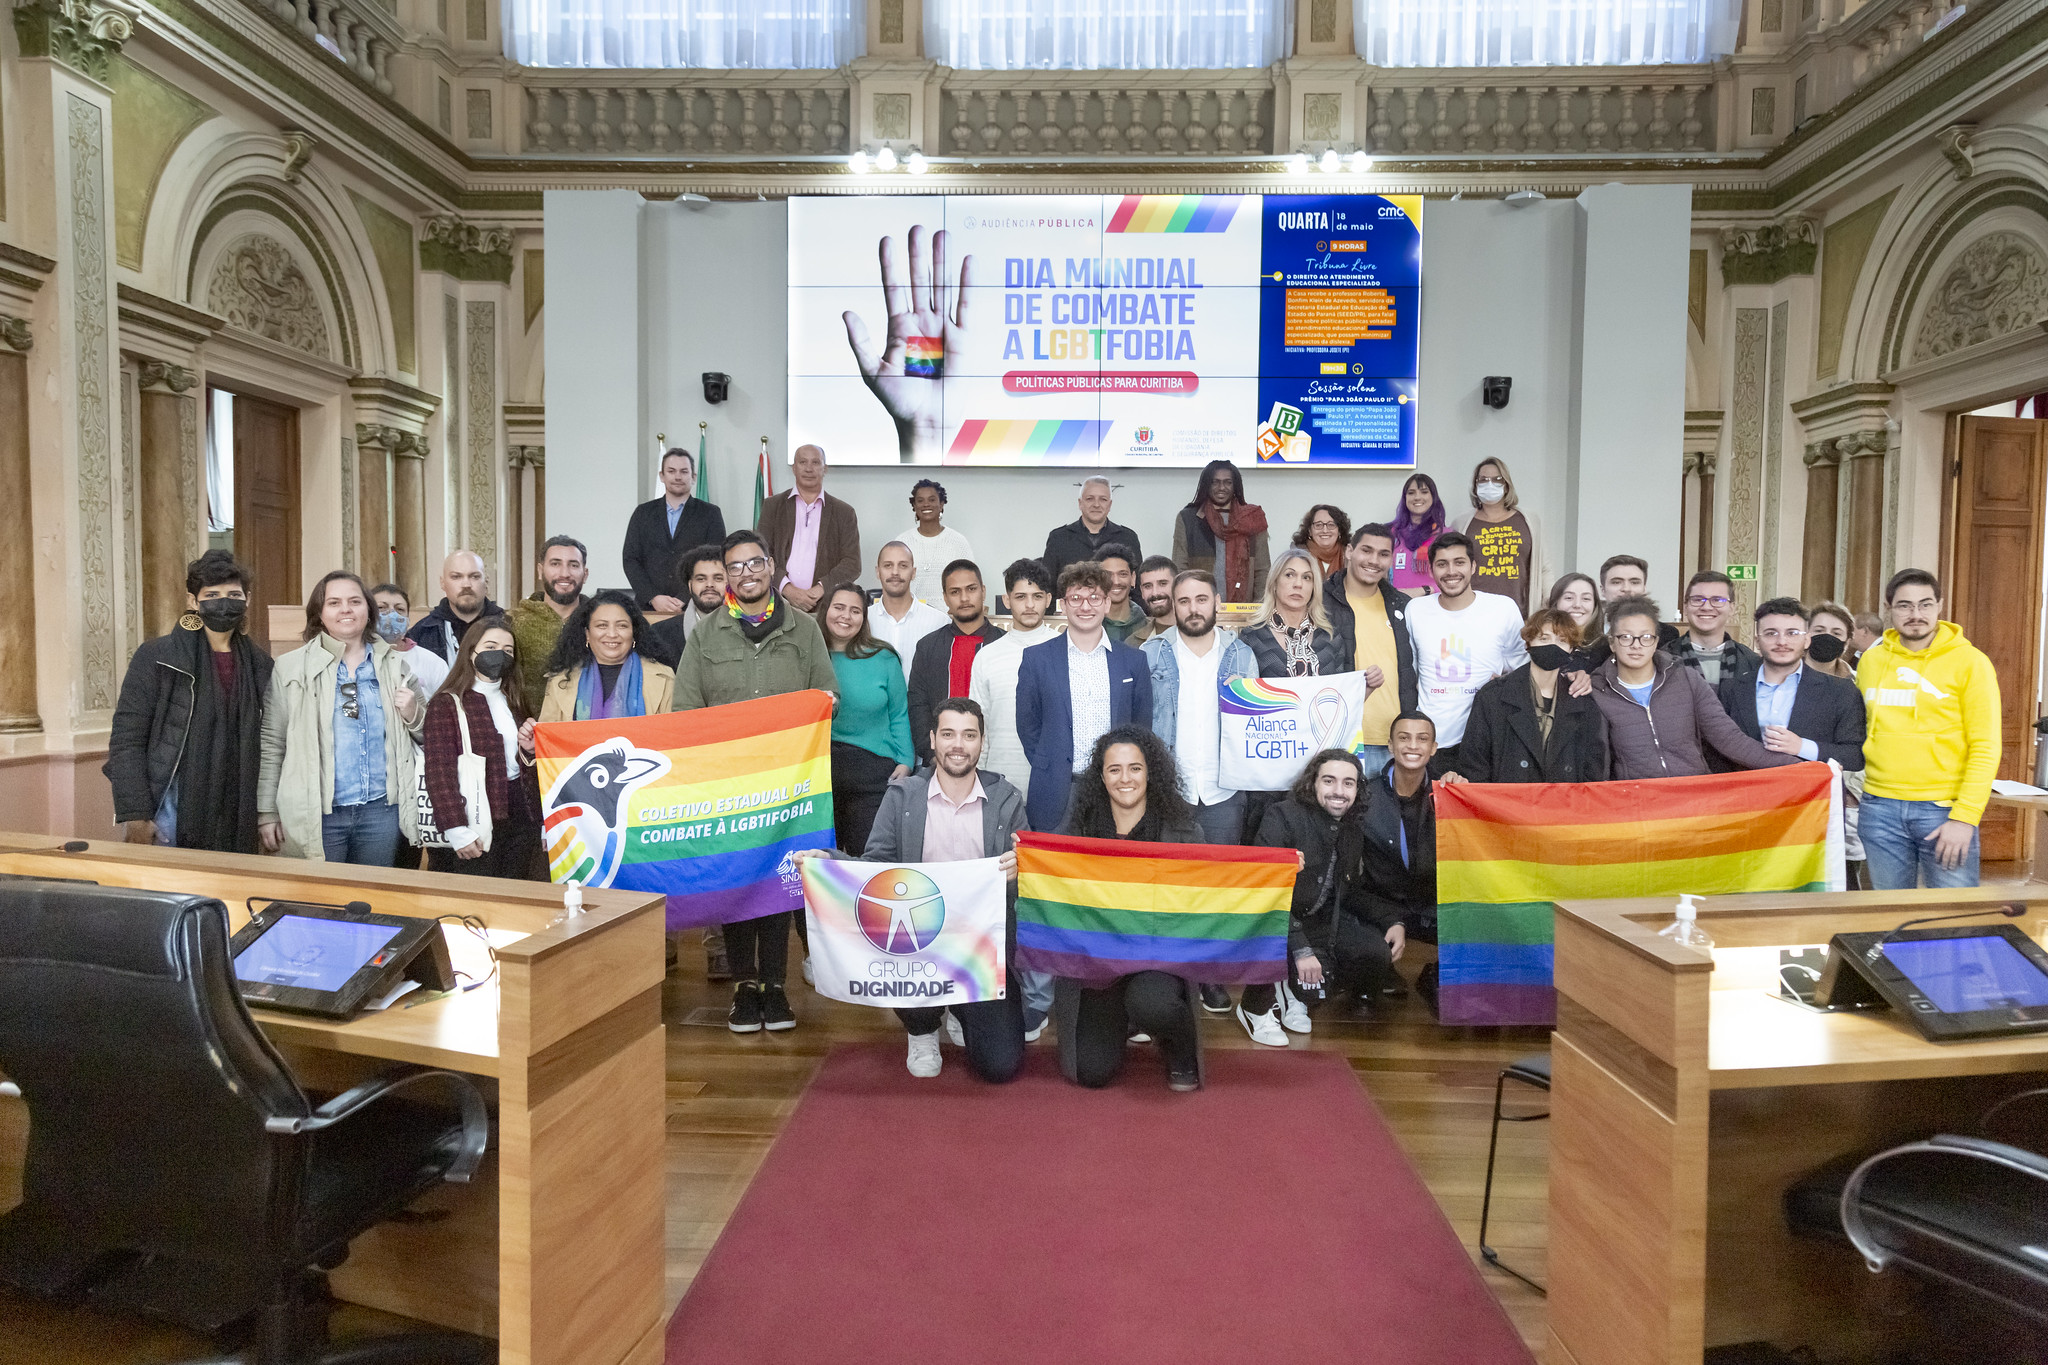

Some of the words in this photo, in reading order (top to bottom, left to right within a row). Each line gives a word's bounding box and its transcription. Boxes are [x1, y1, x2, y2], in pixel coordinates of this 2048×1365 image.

[1378, 207, 1404, 216] cmc
[982, 218, 1035, 227] AUDIÊNCIA
[1039, 217, 1094, 227] PÚBLICA
[1279, 212, 1328, 231] QUARTA
[1306, 253, 1348, 271] Tribuna
[1351, 258, 1377, 272] Livre
[1005, 258, 1056, 288] DIA
[1066, 258, 1203, 288] MUNDIAL
[1005, 294, 1042, 324] DE
[1052, 294, 1195, 324] COMBATE
[1003, 330, 1024, 360] A
[1034, 330, 1196, 360] LGBTFOBIA
[1016, 376, 1064, 388] POLÍTICAS
[1067, 376, 1112, 388] PÚBLICAS
[1114, 378, 1138, 388] PARA
[1140, 377, 1183, 388] CURITIBA
[1308, 381, 1345, 394] Sessão
[1347, 378, 1376, 392] solene
[1280, 412, 1296, 429] B
[1263, 438, 1278, 454] A
[1482, 545, 1519, 556] CRISE,
[1488, 556, 1494, 566] É
[1499, 556, 1513, 565] UM
[1479, 565, 1519, 576] PROJETO!
[1246, 716, 1296, 736] Aliança
[1246, 740, 1308, 759] LGBTI+
[638, 802, 712, 822] COLETIVO
[716, 787, 789, 813] ESTADUAL
[793, 779, 811, 796] DE
[640, 824, 711, 844] COMBATE
[715, 818, 726, 835] À
[730, 801, 813, 833] LGBTIFOBIA
[869, 961, 937, 977] GRUPO
[849, 980, 954, 997] DIGNIDADE
